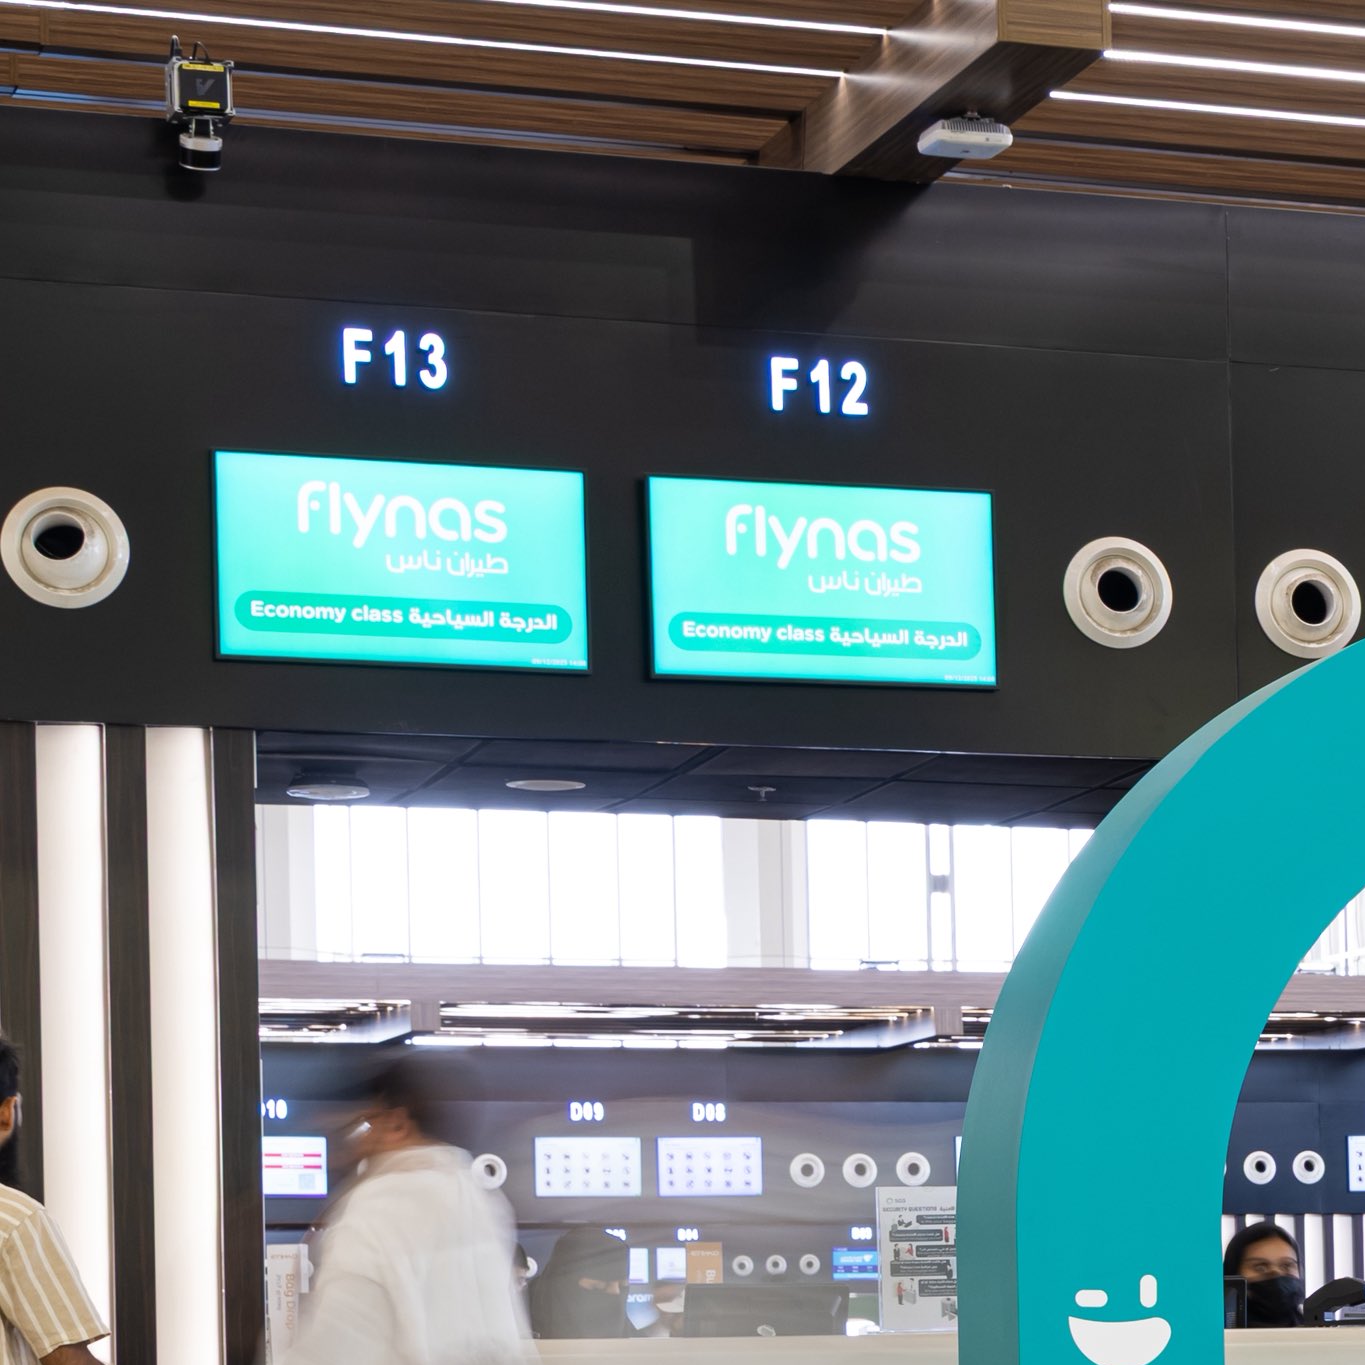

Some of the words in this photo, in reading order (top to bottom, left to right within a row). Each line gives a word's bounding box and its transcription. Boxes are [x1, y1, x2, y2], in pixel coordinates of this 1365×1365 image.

[342, 327, 449, 390] F13
[770, 356, 870, 416] F12
[297, 480, 508, 549] flynas
[725, 504, 921, 570] flynas
[386, 550, 441, 573] ناس
[446, 550, 509, 578] طيران
[808, 570, 859, 593] ناس
[864, 572, 923, 597] طيران
[250, 600, 346, 624] Economy
[352, 604, 403, 624] class
[409, 608, 494, 630] السياحية
[499, 611, 557, 632] الدرجة
[682, 620, 771, 643] Economy
[776, 624, 825, 643] class
[830, 626, 909, 648] السياحية
[914, 631, 968, 650] الدرجة
[261, 1099, 288, 1120] 10
[570, 1101, 604, 1122] D09
[693, 1101, 726, 1122] D08
